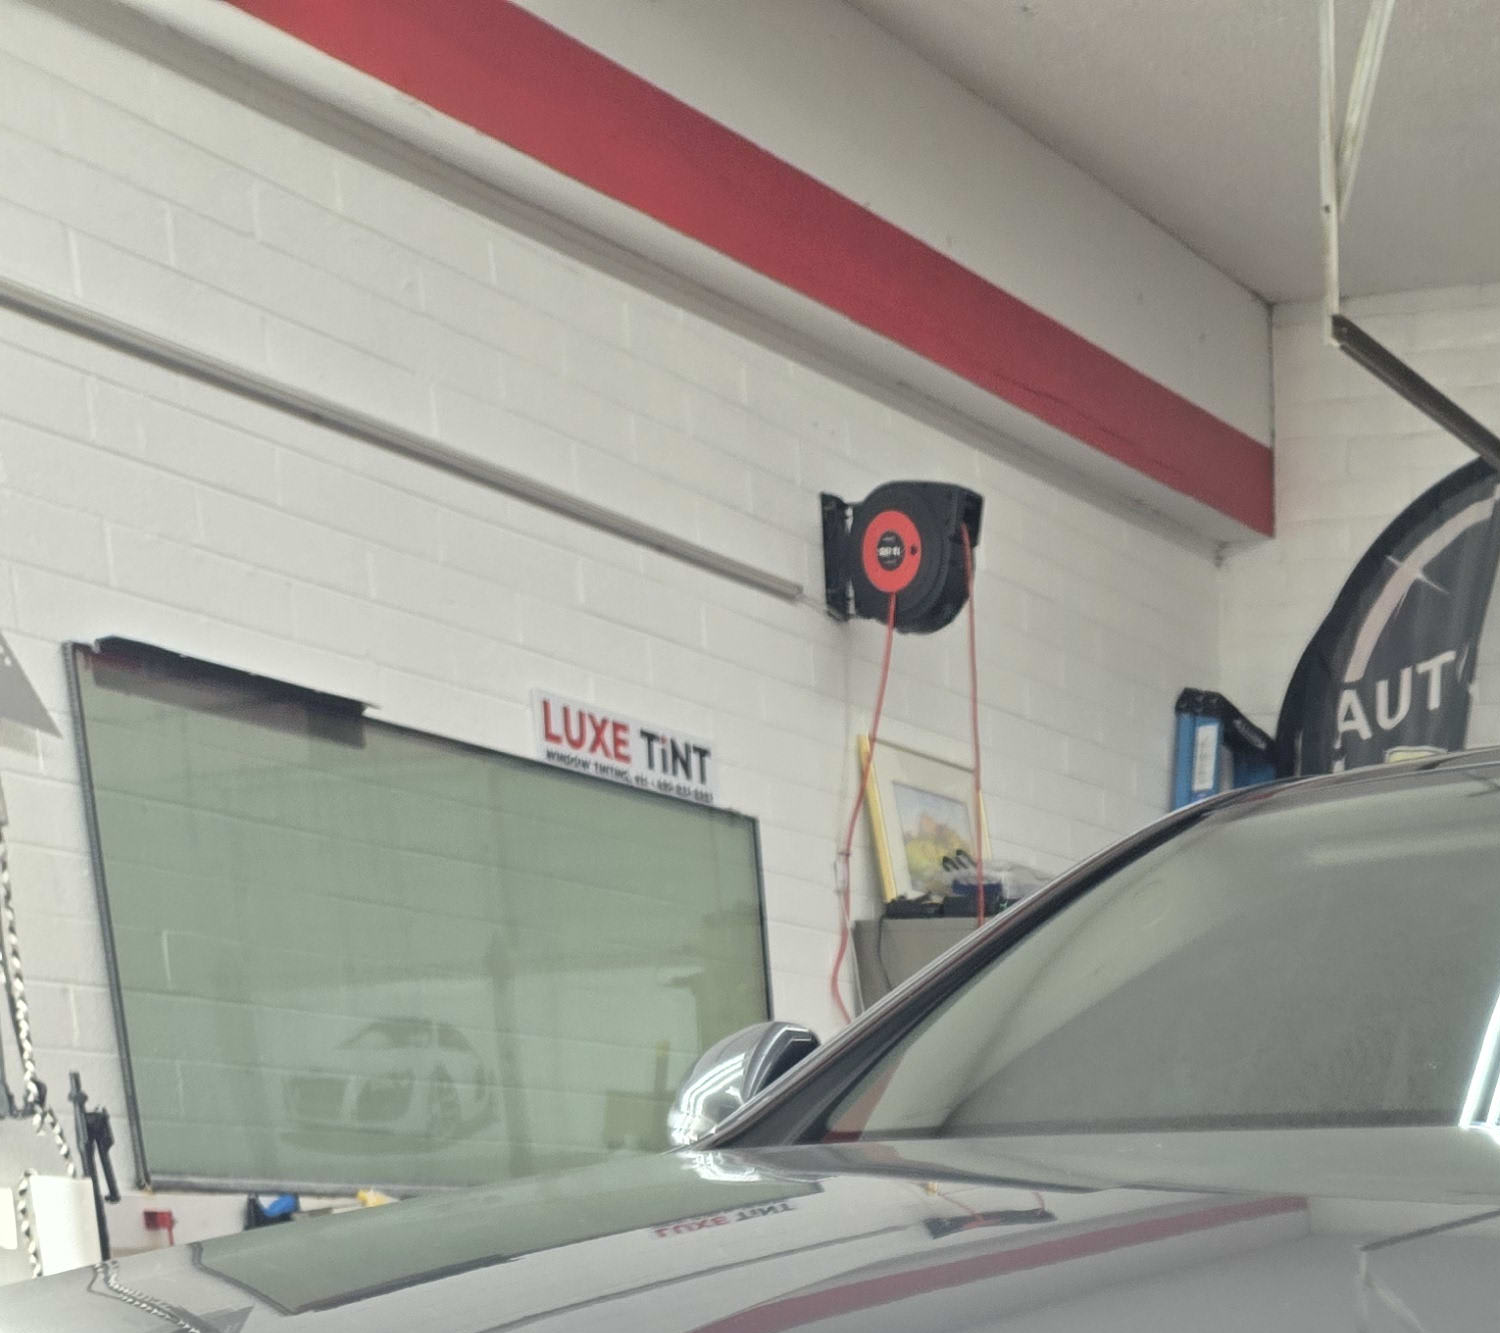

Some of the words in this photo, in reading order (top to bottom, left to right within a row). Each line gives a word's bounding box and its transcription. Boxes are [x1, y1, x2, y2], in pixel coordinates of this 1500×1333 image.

[542, 697, 632, 765] LUXE
[640, 727, 712, 786] TiNT
[1333, 641, 1470, 750] AUT
